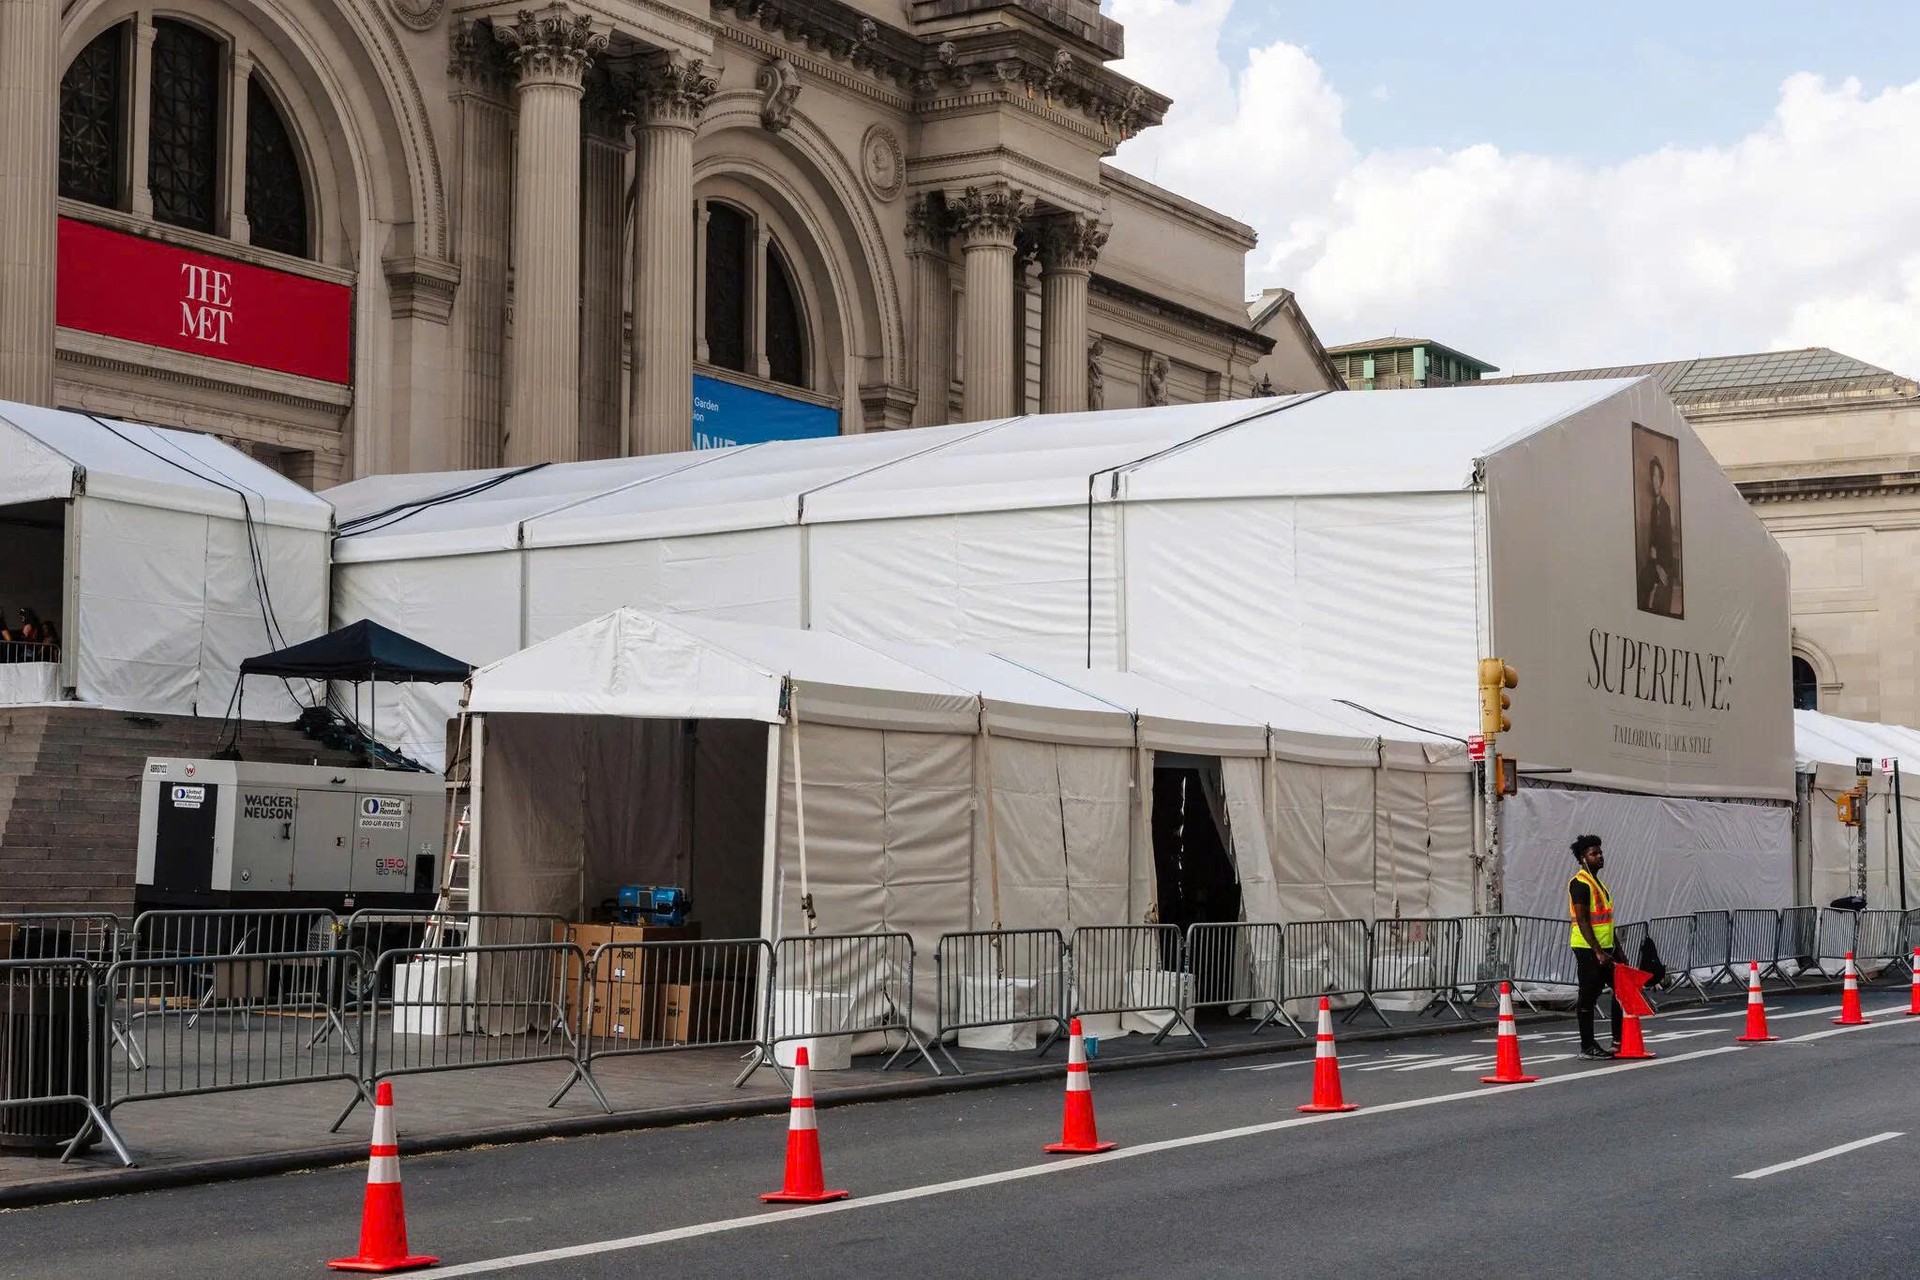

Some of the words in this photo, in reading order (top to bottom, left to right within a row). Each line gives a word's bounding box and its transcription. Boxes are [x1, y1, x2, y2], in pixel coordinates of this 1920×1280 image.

[181, 263, 232, 308] THE
[179, 301, 233, 345] MET
[694, 396, 719, 412] Garden
[693, 409, 705, 422] ion
[1587, 627, 1732, 711] SUPERFINE:
[1613, 724, 1661, 750] TAILORING
[1688, 736, 1712, 755] STYLE
[244, 794, 293, 808] WACKER
[380, 799, 401, 808] United
[244, 806, 293, 820] NEUSON
[380, 807, 402, 816] Rentals
[361, 819, 401, 828] 800-UR-RENTS
[376, 858, 405, 868] G150
[376, 868, 389, 876] 120
